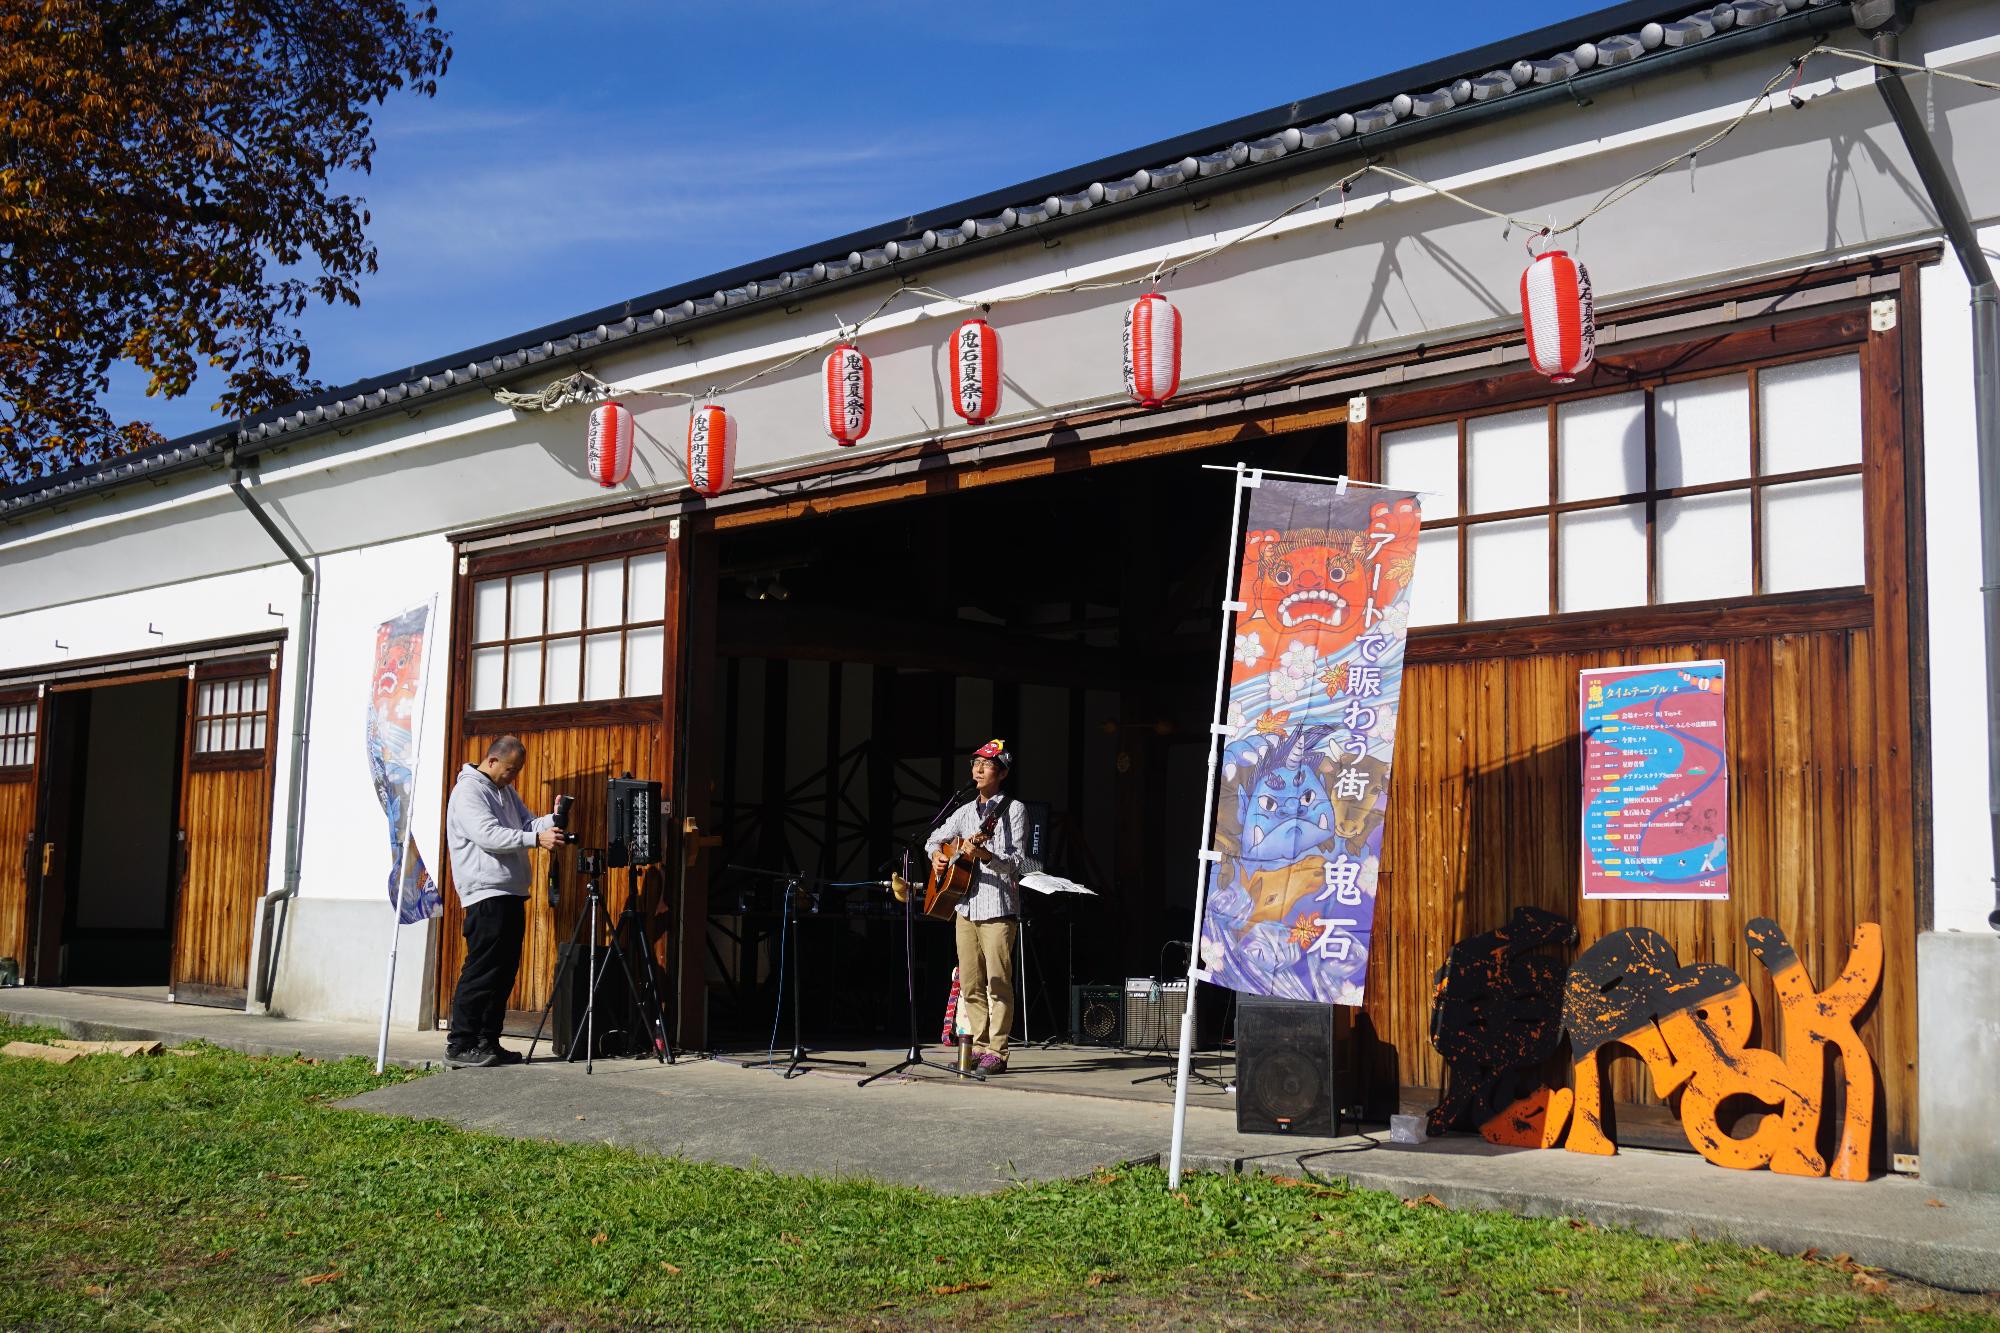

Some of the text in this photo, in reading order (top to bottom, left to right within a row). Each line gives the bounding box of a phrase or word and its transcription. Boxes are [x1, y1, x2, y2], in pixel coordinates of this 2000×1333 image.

[1578, 262, 1595, 362] 鬼石夏祭り
[844, 353, 865, 429] 鬼石夏祭り
[960, 329, 984, 413] 鬼石夏祭り
[690, 414, 710, 488] 鬼石町商工会
[1334, 530, 1396, 802] アートで賑わう街
[1606, 685, 1668, 698] タイムテーブル
[1032, 824, 1041, 855] CUBE
[1307, 854, 1362, 961] 鬼石
